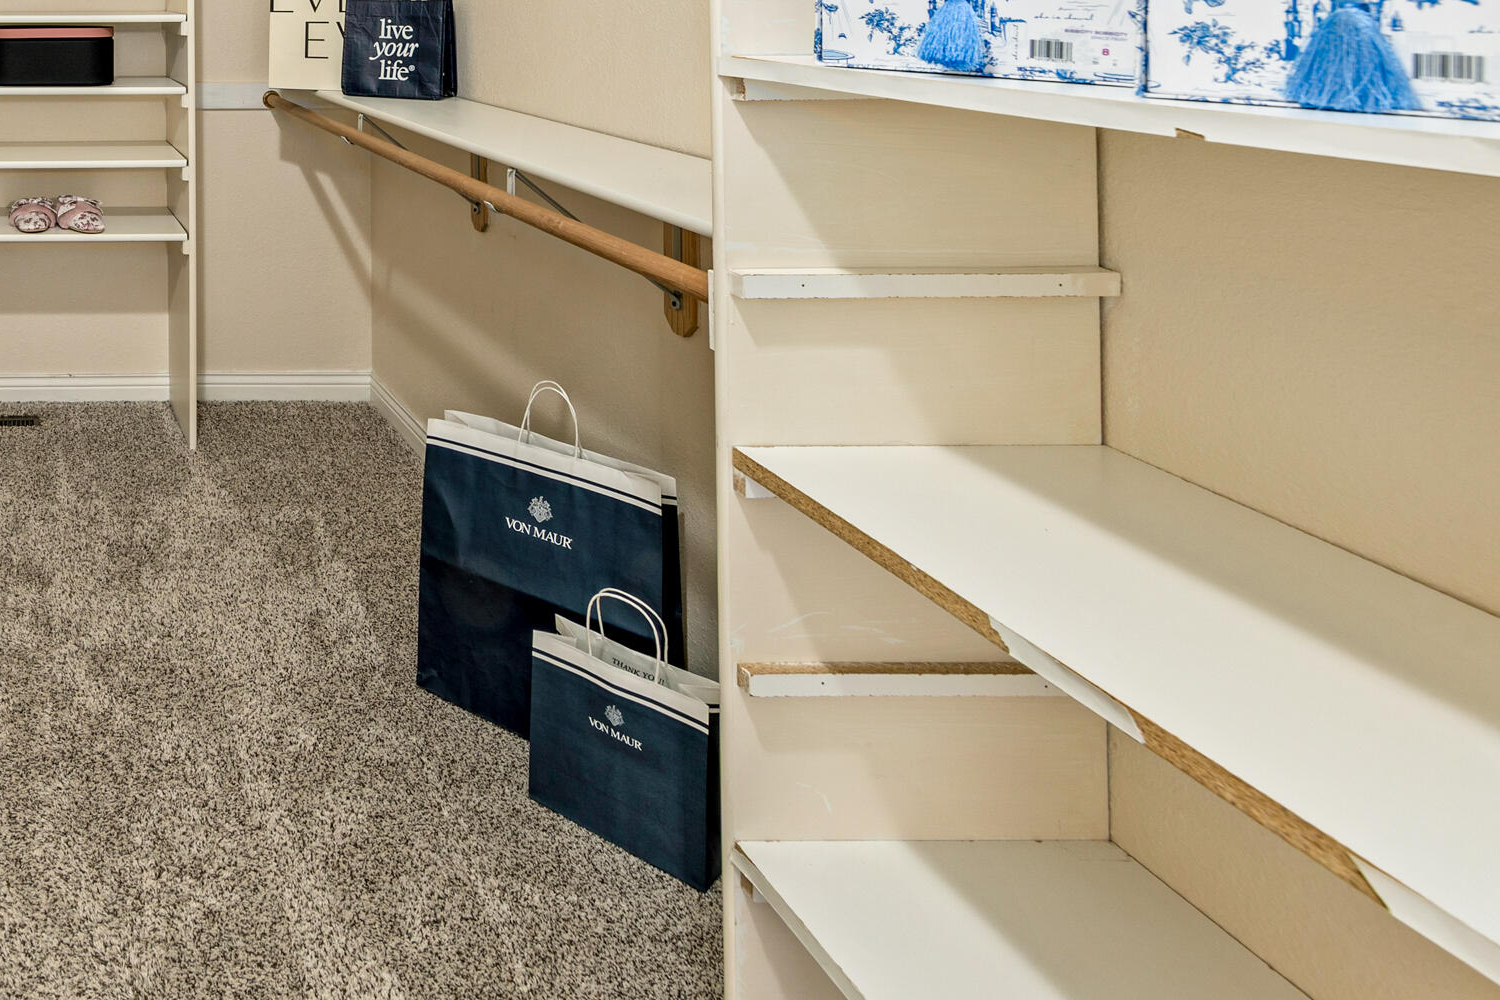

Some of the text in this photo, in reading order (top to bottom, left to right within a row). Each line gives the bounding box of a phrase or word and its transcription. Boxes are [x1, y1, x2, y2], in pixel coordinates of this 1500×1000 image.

[378, 18, 414, 40] live
[368, 41, 419, 61] your
[504, 516, 573, 550] VON MAUR
[612, 657, 642, 677] THANK
[588, 716, 644, 751] VON MAUR
